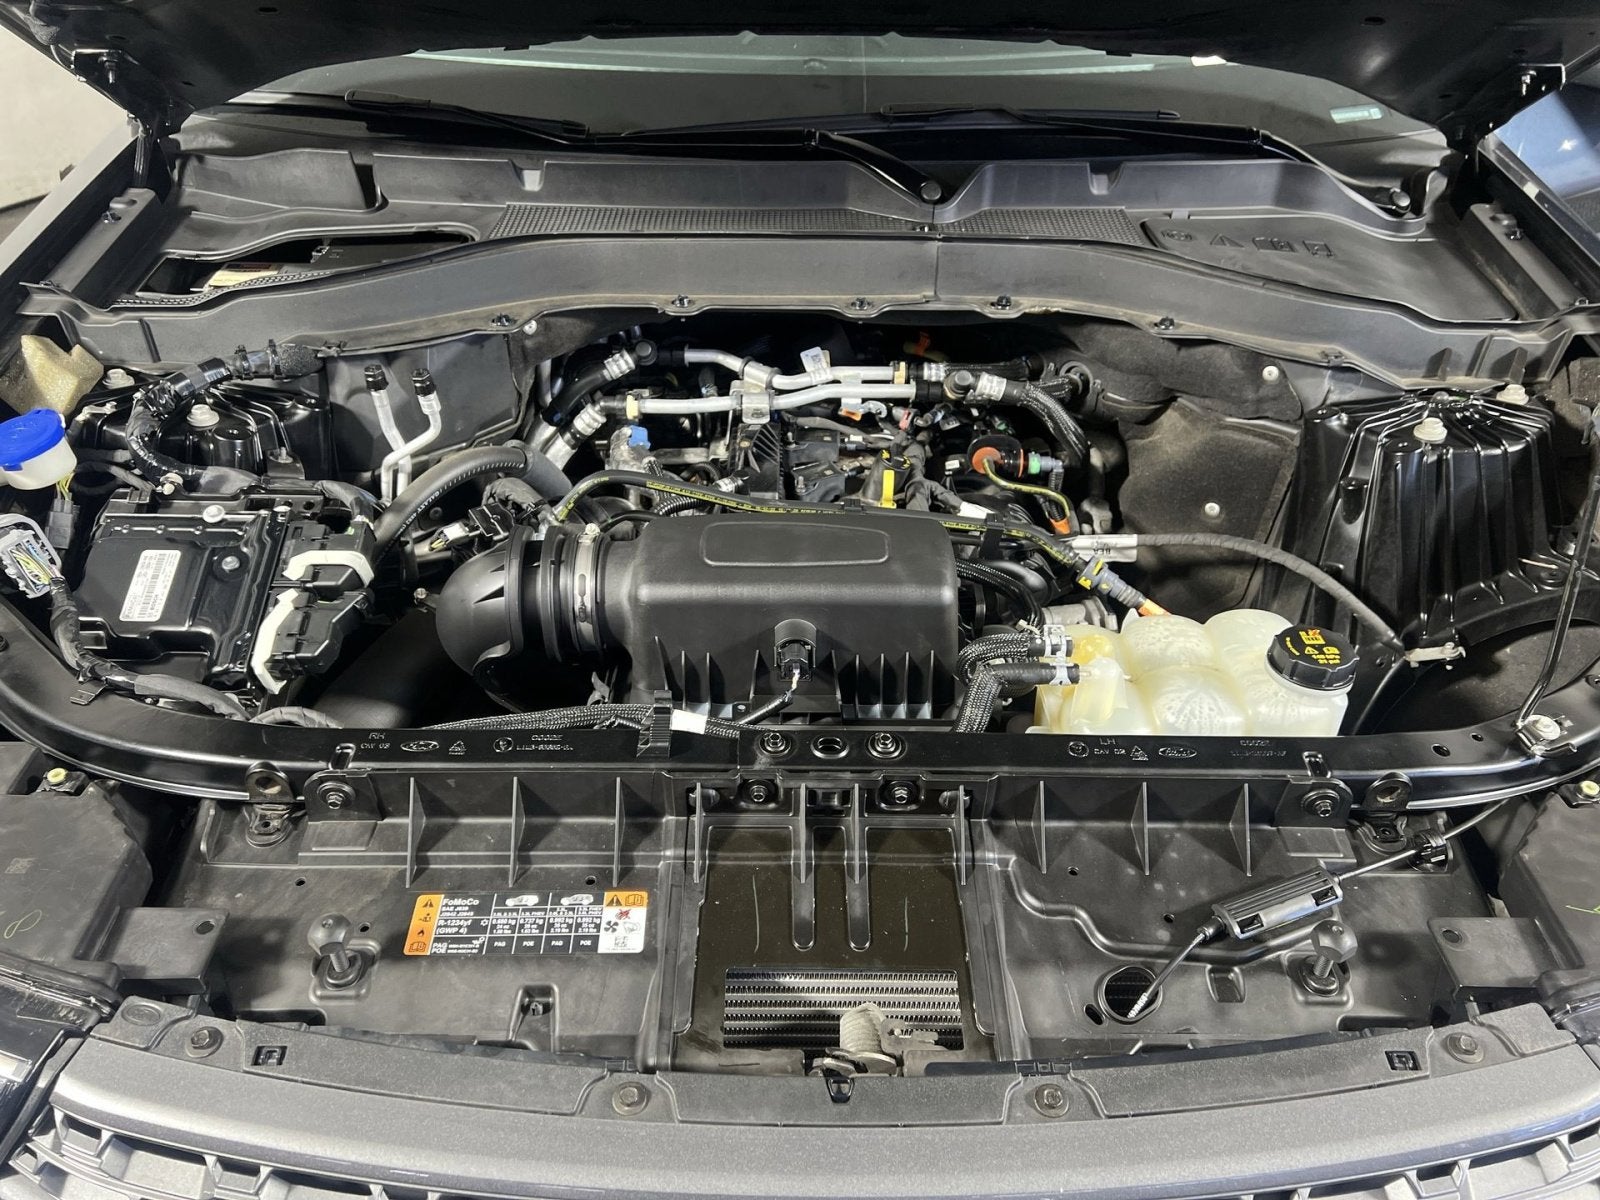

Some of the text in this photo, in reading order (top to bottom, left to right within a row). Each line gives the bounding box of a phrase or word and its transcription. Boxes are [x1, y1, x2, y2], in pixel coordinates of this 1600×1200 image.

[442, 897, 480, 906] FoMoCo
[437, 919, 473, 927] R-1234yf
[436, 927, 468, 935] (GWP 4)
